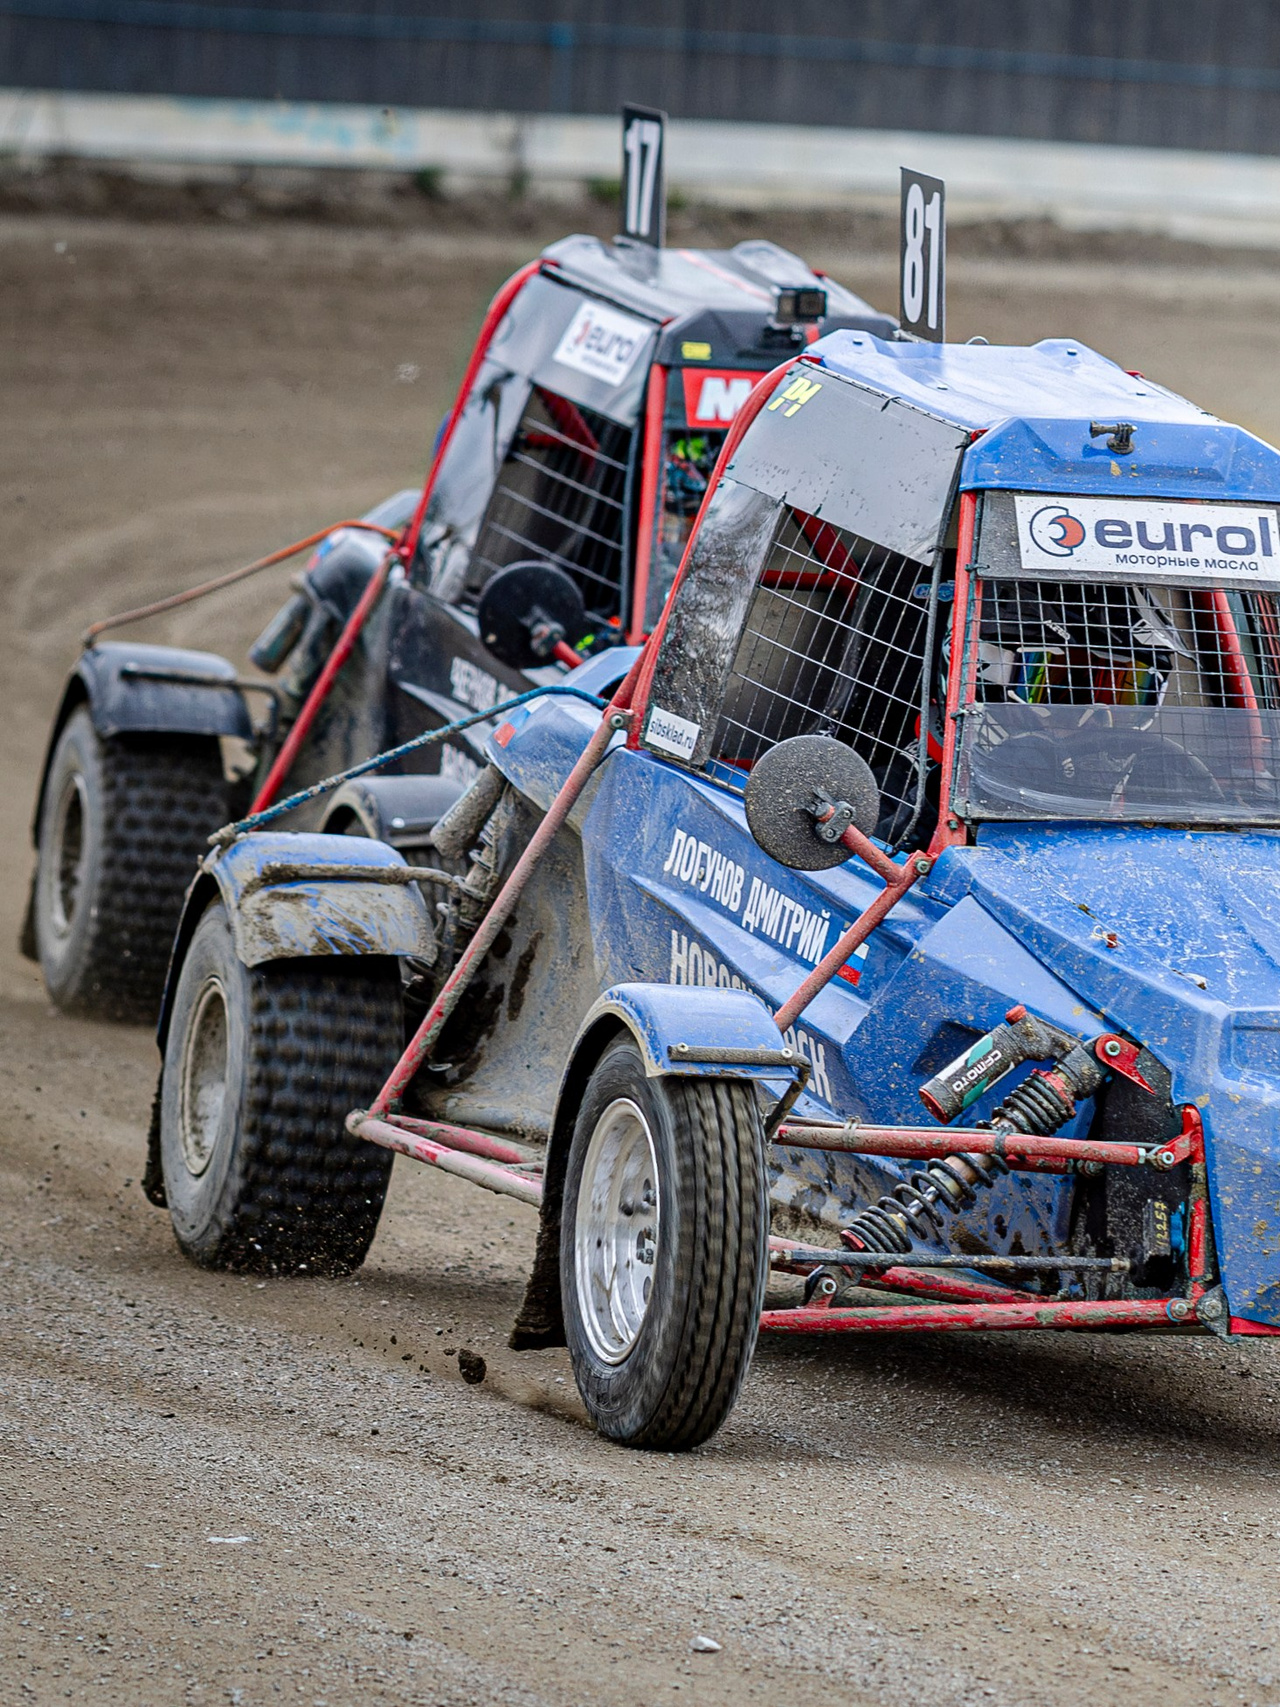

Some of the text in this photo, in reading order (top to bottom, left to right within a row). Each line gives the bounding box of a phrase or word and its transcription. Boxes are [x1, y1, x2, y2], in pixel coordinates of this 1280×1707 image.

[626, 118, 661, 236] 17
[903, 183, 941, 330] 81
[1094, 516, 1274, 557] eurol
[1115, 553, 1259, 572] моторные масла
[650, 717, 694, 750] sibsklad.ru
[662, 828, 831, 967] ЛОГУНОВ ДМИТРИЙ
[951, 1049, 1002, 1093] CFMOTO
